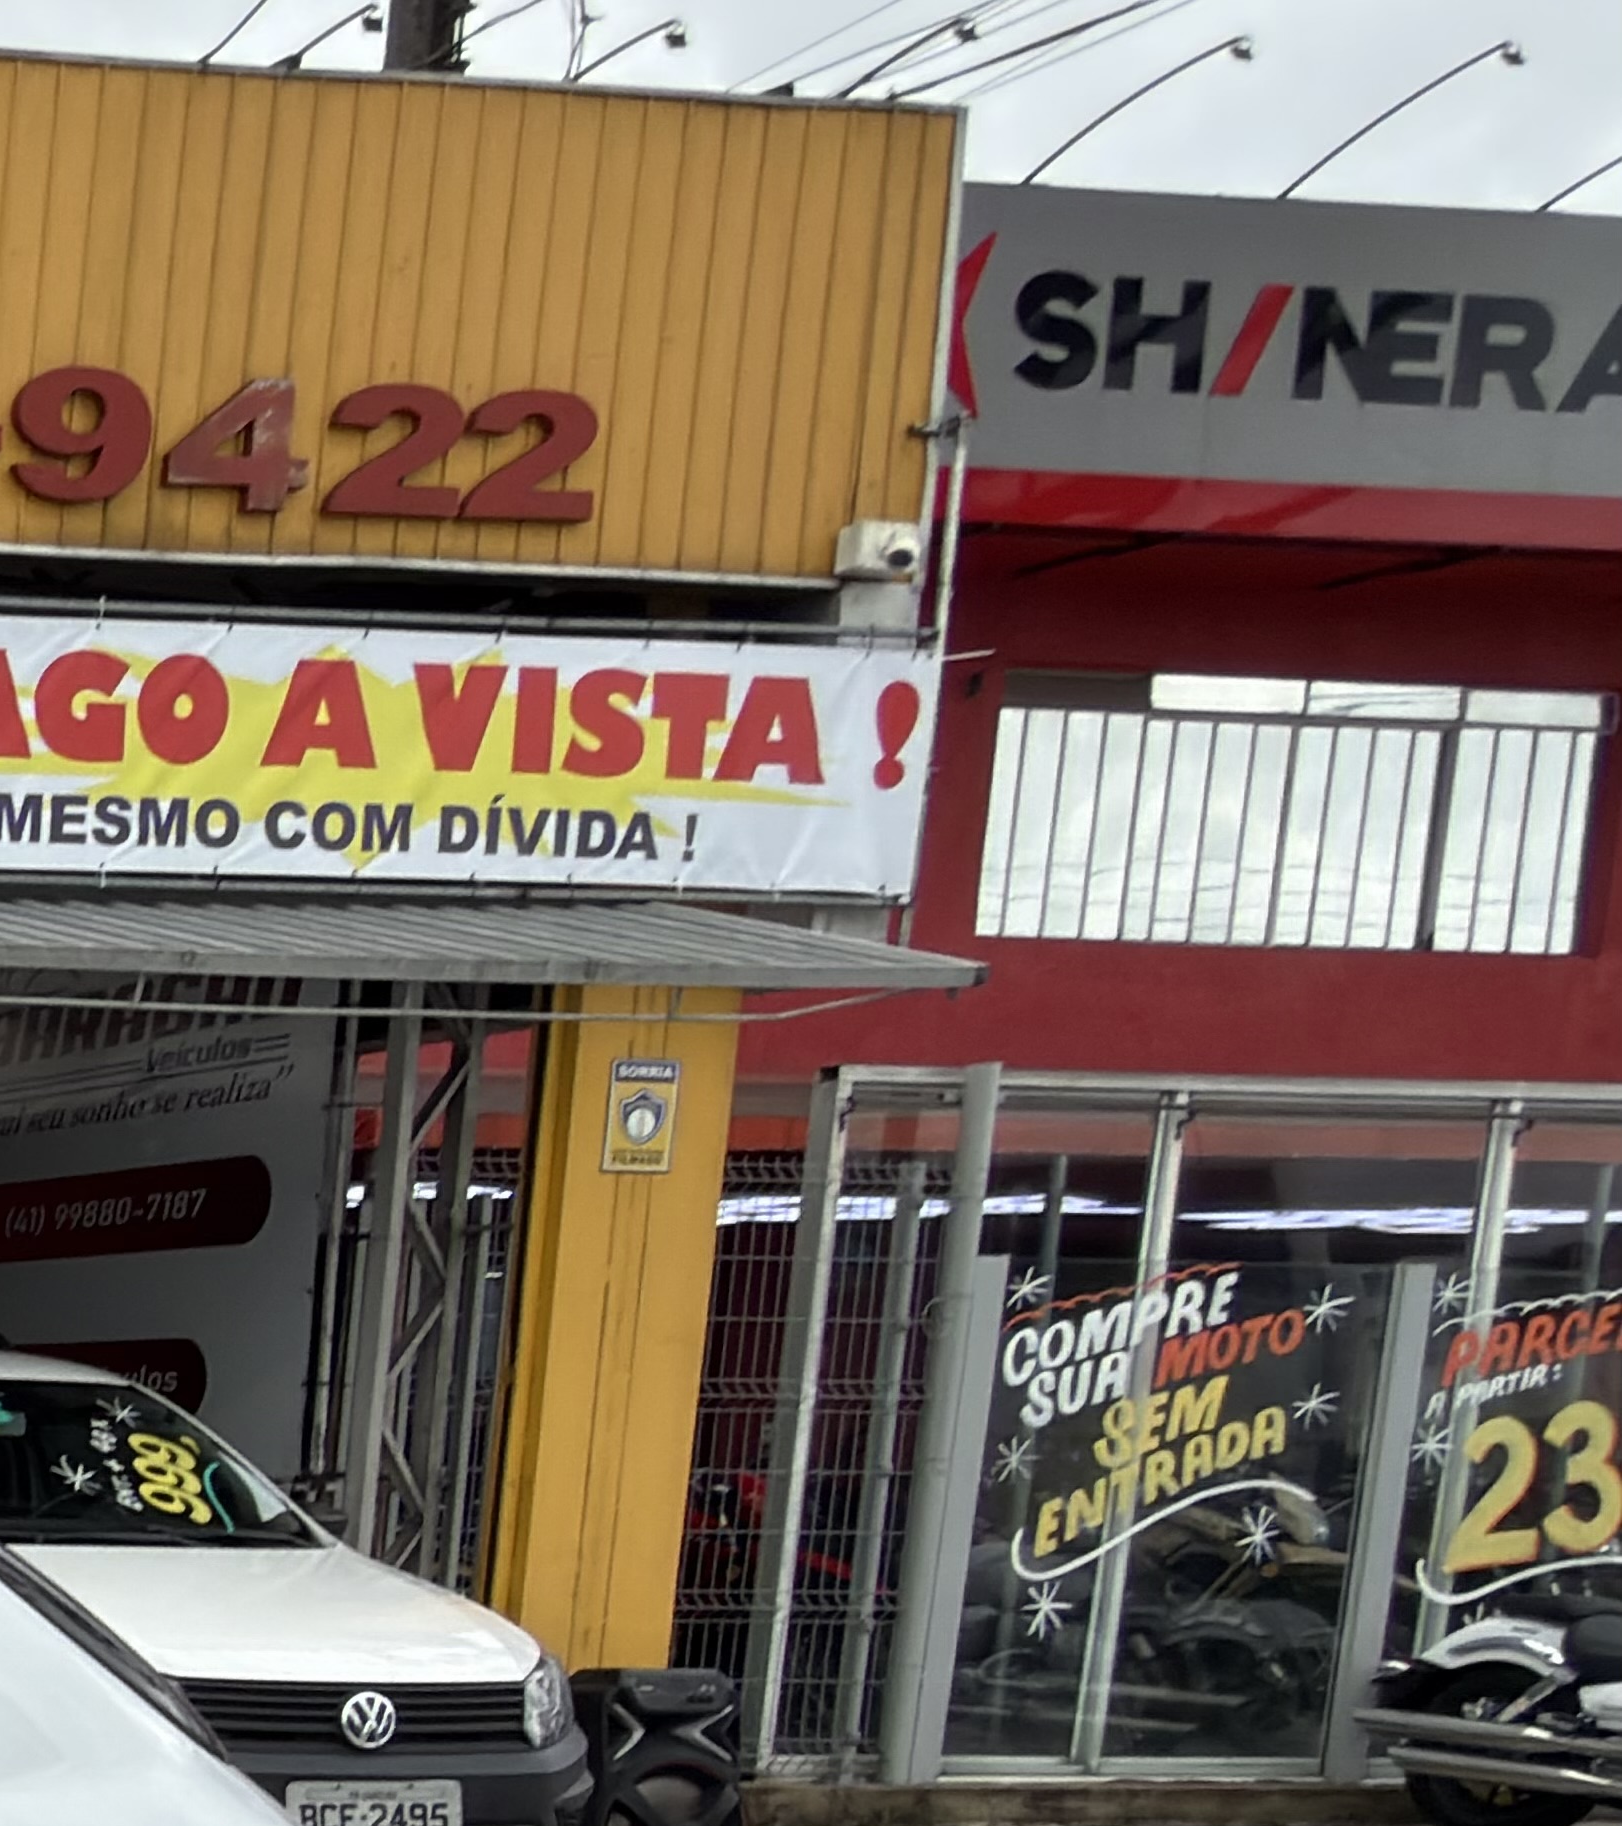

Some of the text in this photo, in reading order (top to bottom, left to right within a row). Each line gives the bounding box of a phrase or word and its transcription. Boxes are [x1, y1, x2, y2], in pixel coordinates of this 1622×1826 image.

[261, 658, 377, 769] A
[414, 662, 824, 786] VISTA
[264, 801, 416, 854] COM
[437, 795, 658, 862] DÍVIDA
[617, 1064, 674, 1078] SORRIA
[4, 1186, 210, 1240] (41) 99880-7187
[1002, 1272, 1238, 1386] COMPRE
[1020, 1309, 1306, 1427] SUA MOTO
[1441, 1303, 1622, 1388] PARCE
[1093, 1375, 1229, 1468] SEM
[1035, 1406, 1286, 1558] ENTRADA
